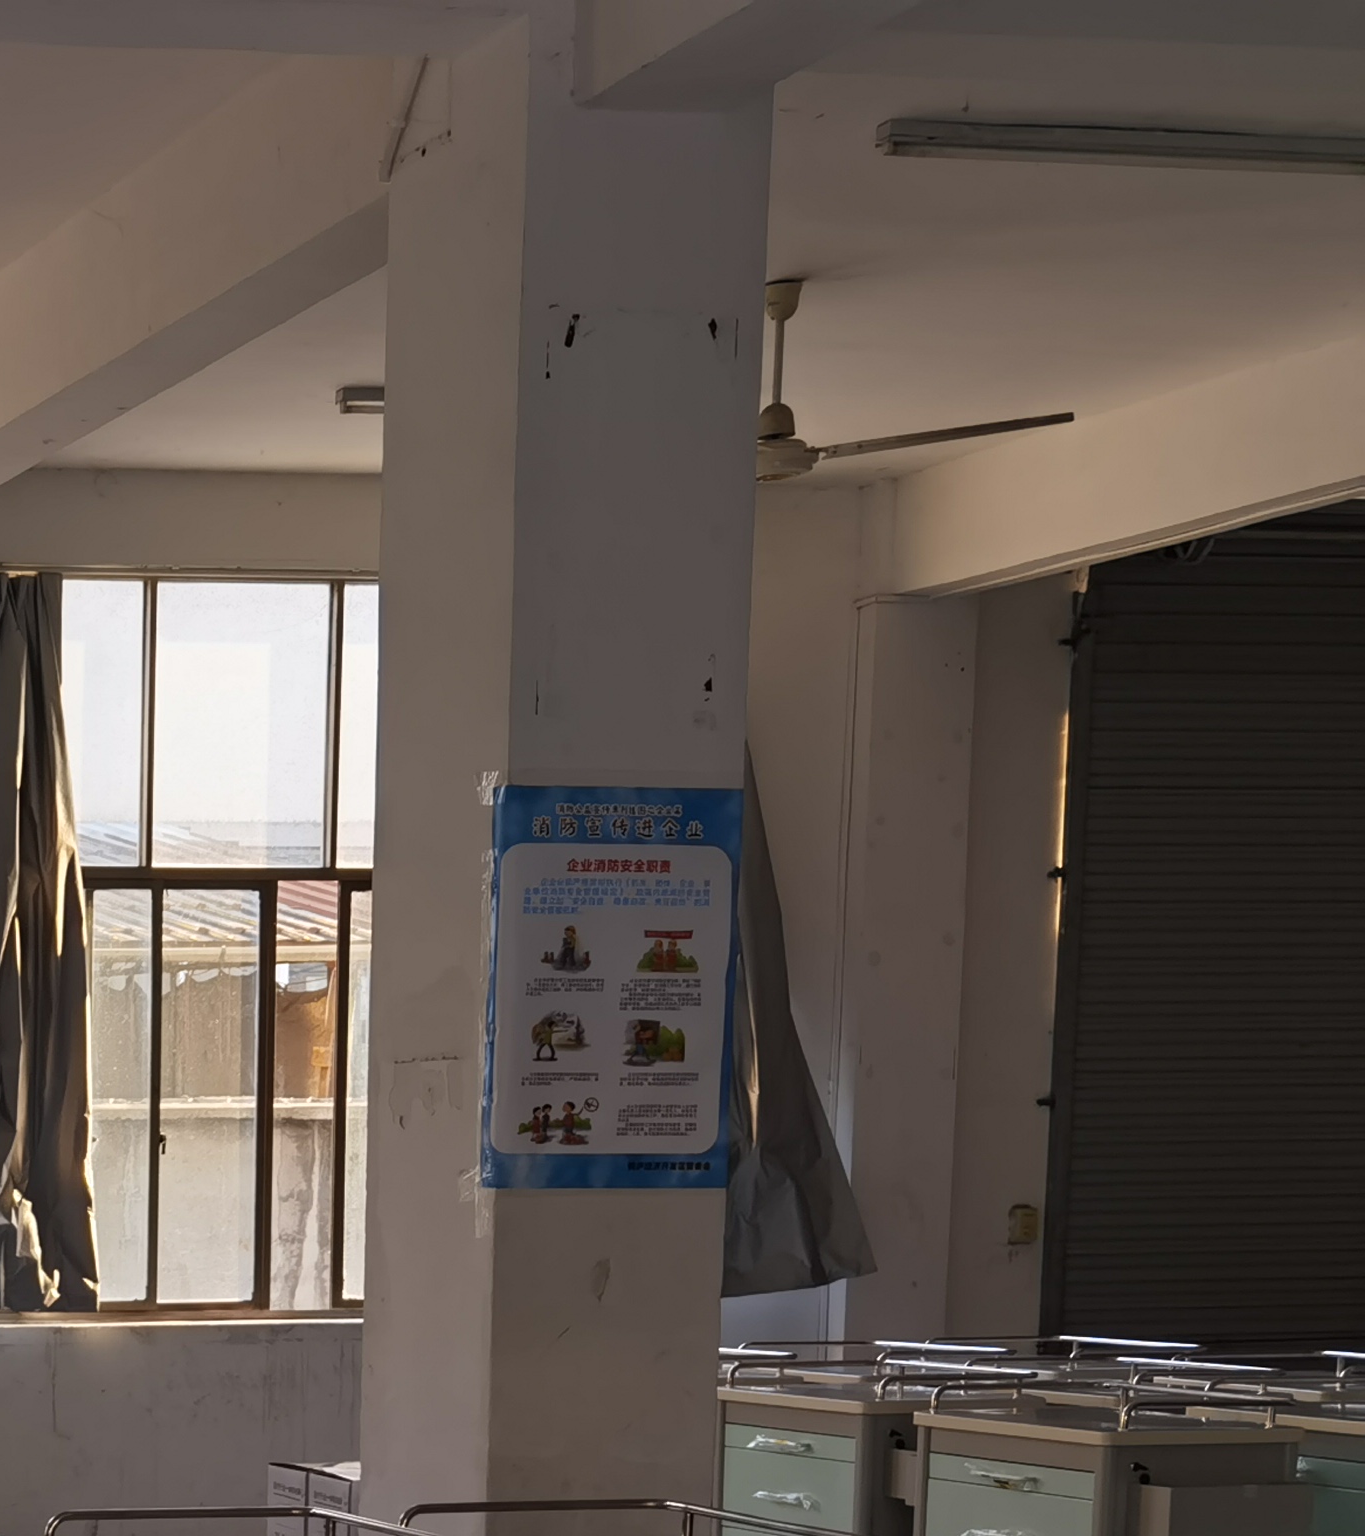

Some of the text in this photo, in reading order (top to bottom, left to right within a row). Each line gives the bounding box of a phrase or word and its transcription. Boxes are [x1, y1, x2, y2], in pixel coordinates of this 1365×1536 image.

[532, 816, 705, 839] 消防宣传进企业
[567, 858, 672, 874] 企业消防安全职责
